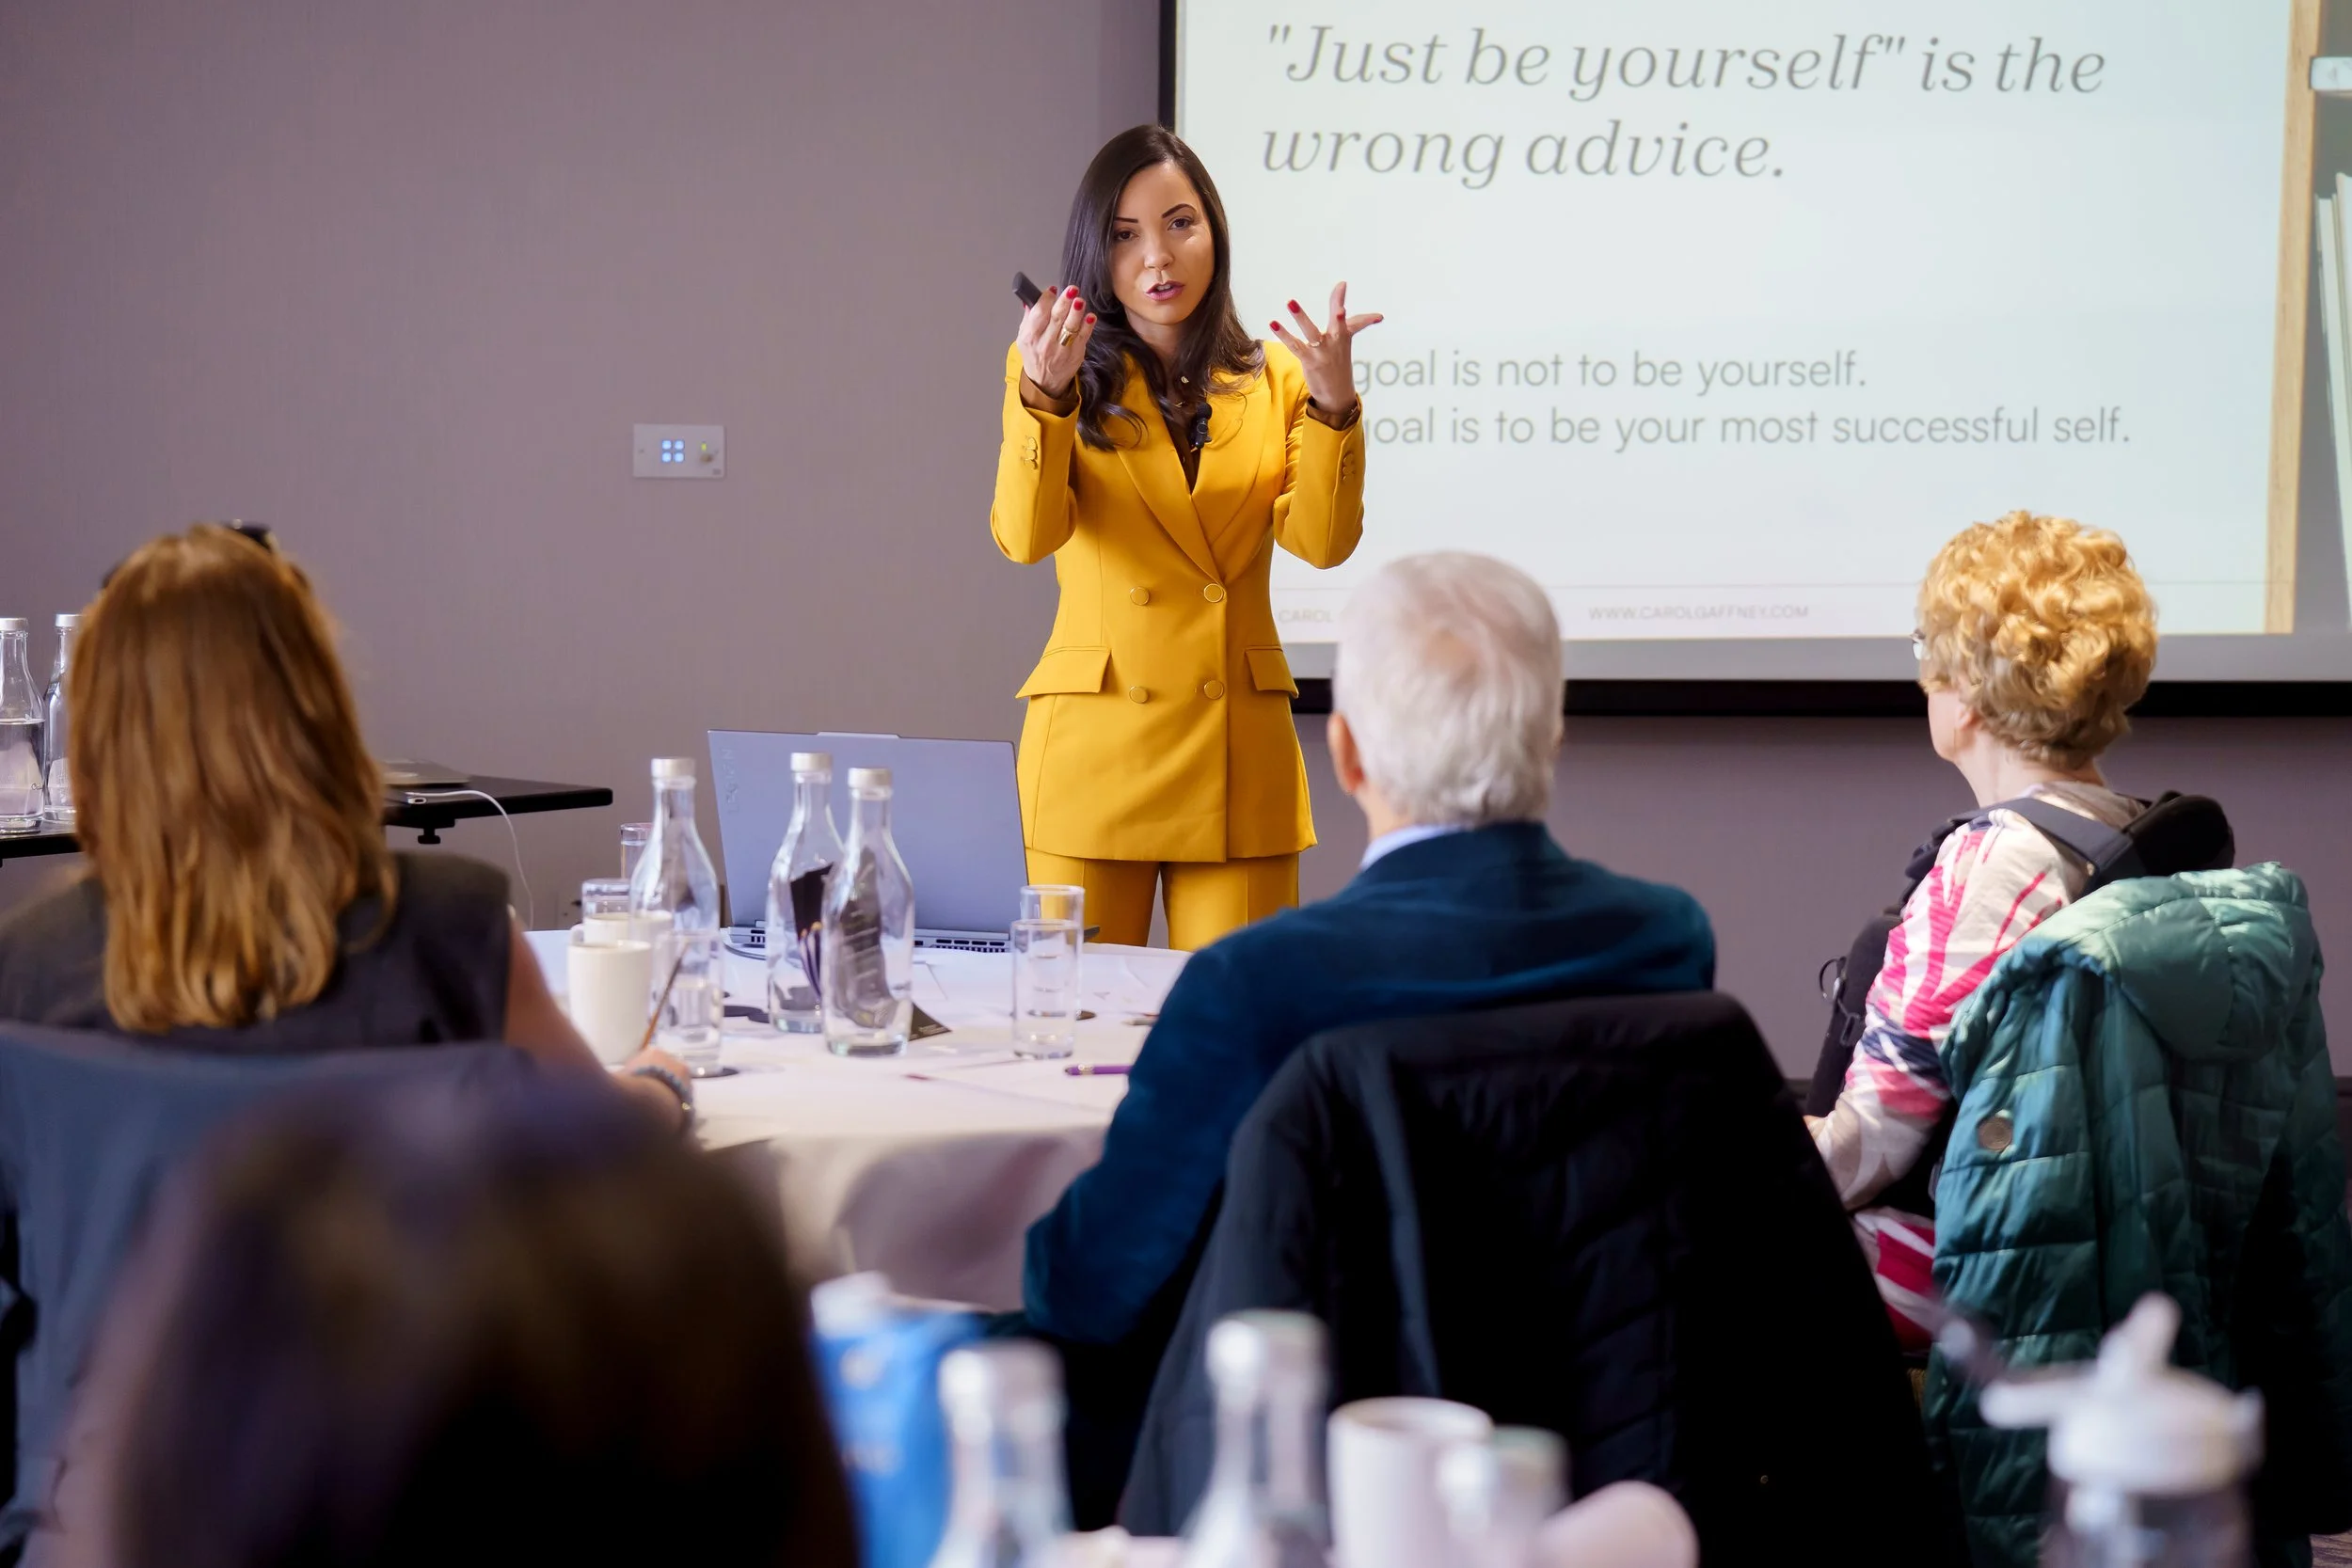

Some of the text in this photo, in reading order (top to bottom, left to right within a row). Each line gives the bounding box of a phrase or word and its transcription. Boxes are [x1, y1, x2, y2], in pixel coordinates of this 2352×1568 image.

[1268, 23, 2106, 103] "Just be yourself" is the
[1263, 119, 1784, 190] wrong advice.
[1352, 349, 1867, 397] goal is not to be yourself.
[1452, 406, 1480, 444] is
[1494, 410, 1535, 444] to
[1550, 406, 1601, 444] be
[1614, 417, 1707, 454] your
[1721, 410, 1820, 444] most
[1833, 405, 2040, 444] successful
[2053, 405, 2130, 444] self.
[1588, 605, 1810, 621] WWW.CAROLGAFFNEY.COM
